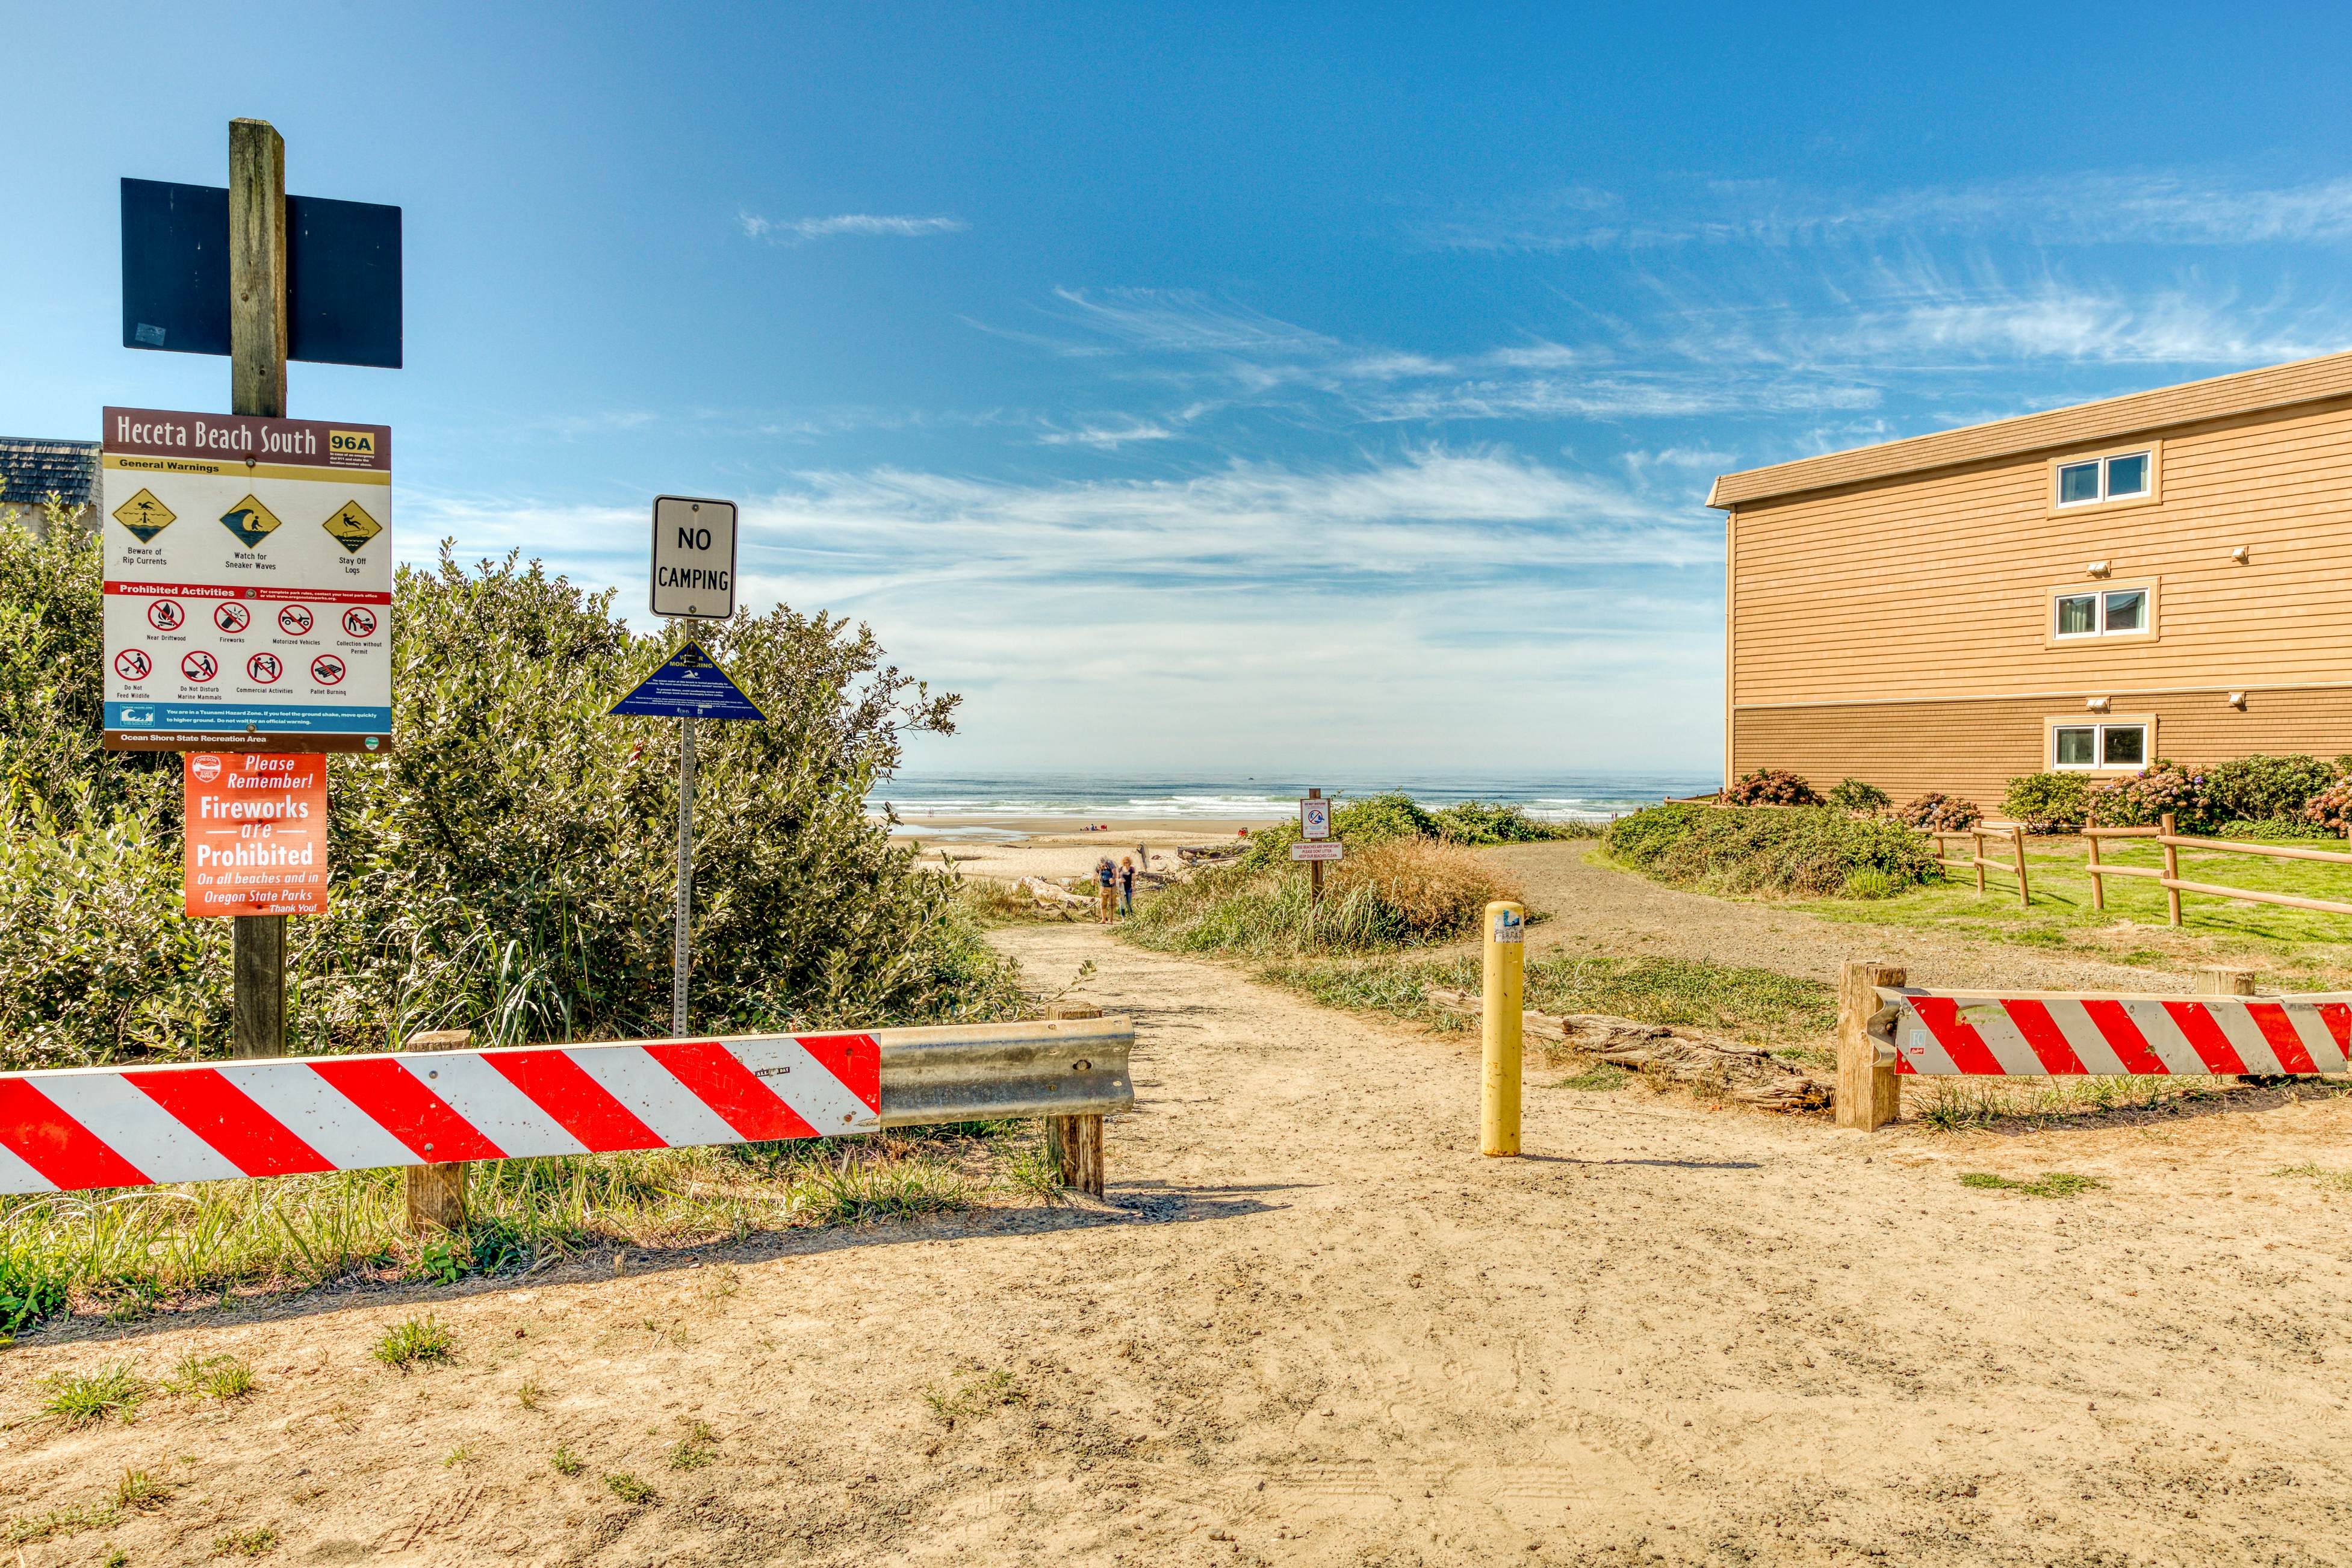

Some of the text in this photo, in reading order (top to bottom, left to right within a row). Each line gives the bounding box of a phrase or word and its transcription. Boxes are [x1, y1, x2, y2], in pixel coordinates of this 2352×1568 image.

[117, 416, 315, 454] Heceta Beach South
[332, 436, 372, 451] 96A
[120, 459, 219, 473] General Warnings
[678, 527, 711, 550] NO
[123, 556, 134, 565] Rip
[339, 557, 354, 566] Stay
[346, 566, 360, 575] Logs
[659, 566, 728, 591] CAMPING
[120, 584, 235, 597] Prohibited Activities
[245, 755, 294, 770] Please
[228, 773, 313, 789] Remember!
[201, 795, 308, 819] Fireworks
[241, 823, 272, 838] are
[197, 842, 312, 867] Prohibited
[197, 871, 318, 885] On all beaches and in
[204, 889, 312, 905] Oregon State Parks
[298, 903, 317, 912] You!
